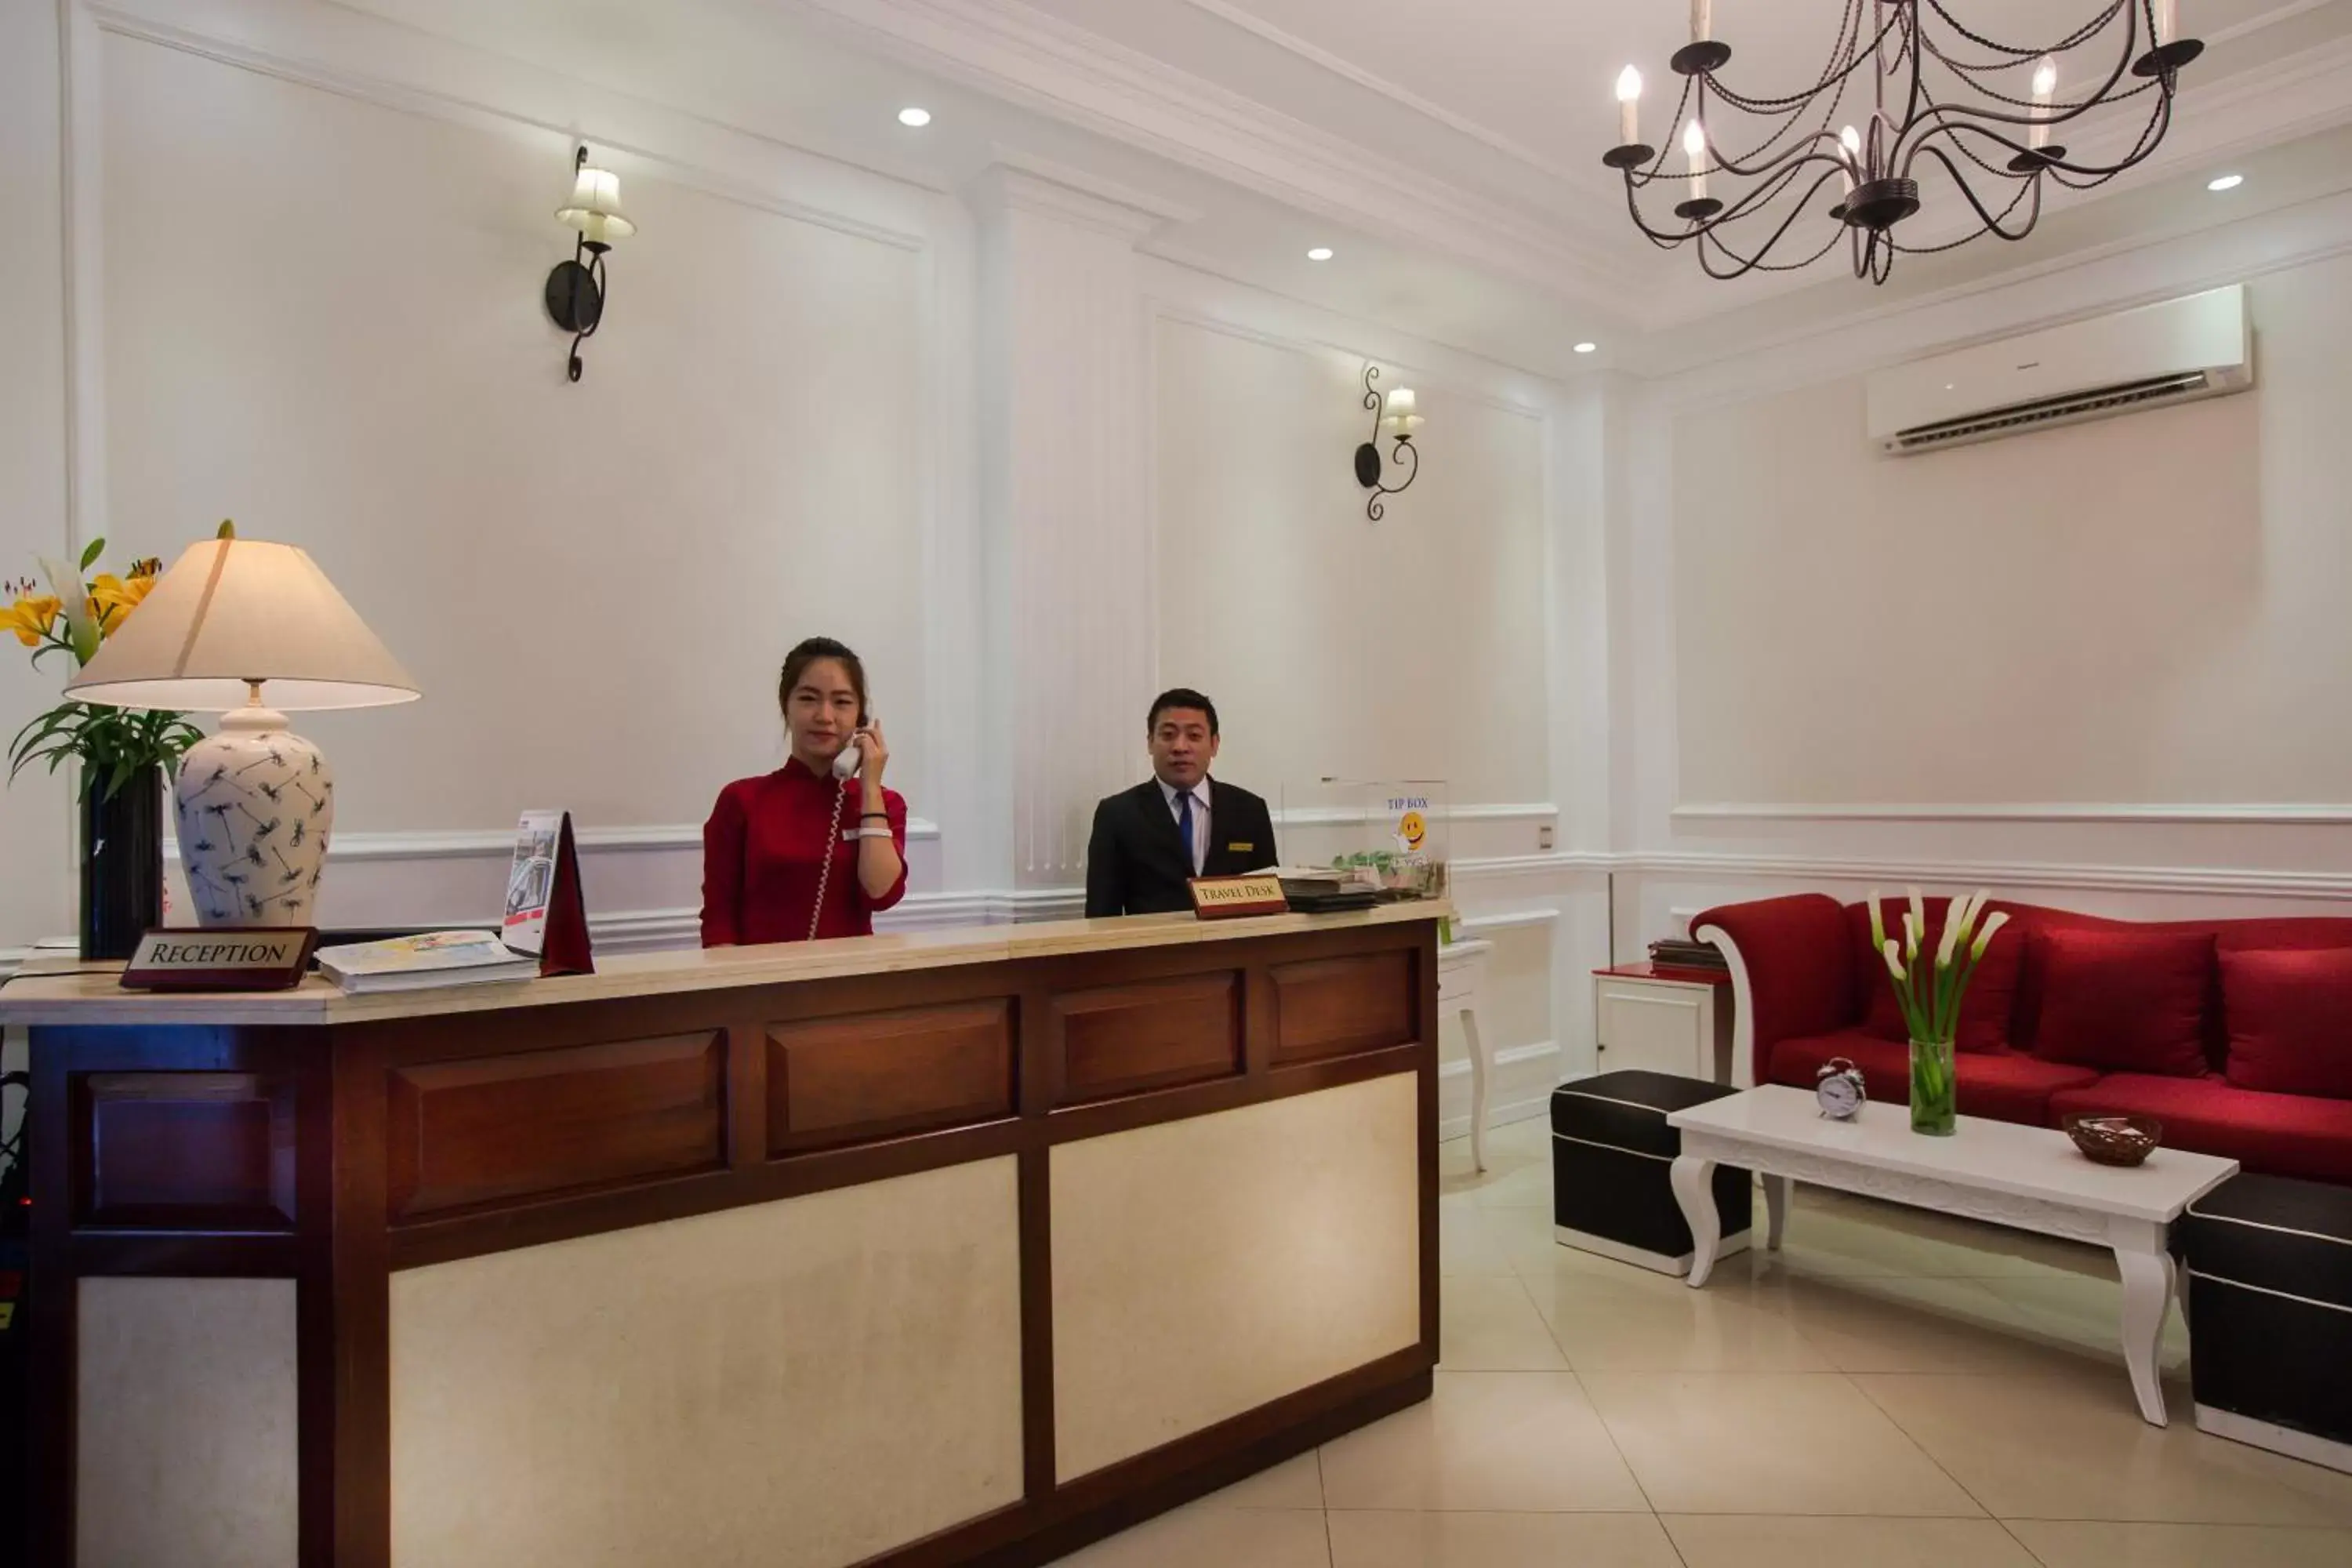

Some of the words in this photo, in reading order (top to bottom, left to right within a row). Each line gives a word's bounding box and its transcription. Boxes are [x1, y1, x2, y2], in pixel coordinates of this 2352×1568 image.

[1387, 798, 1405, 810] TIP
[1407, 797, 1428, 809] BOX
[1199, 887, 1243, 901] TRAVEL
[1244, 884, 1274, 897] DESK
[149, 942, 287, 964] RECEPTION
